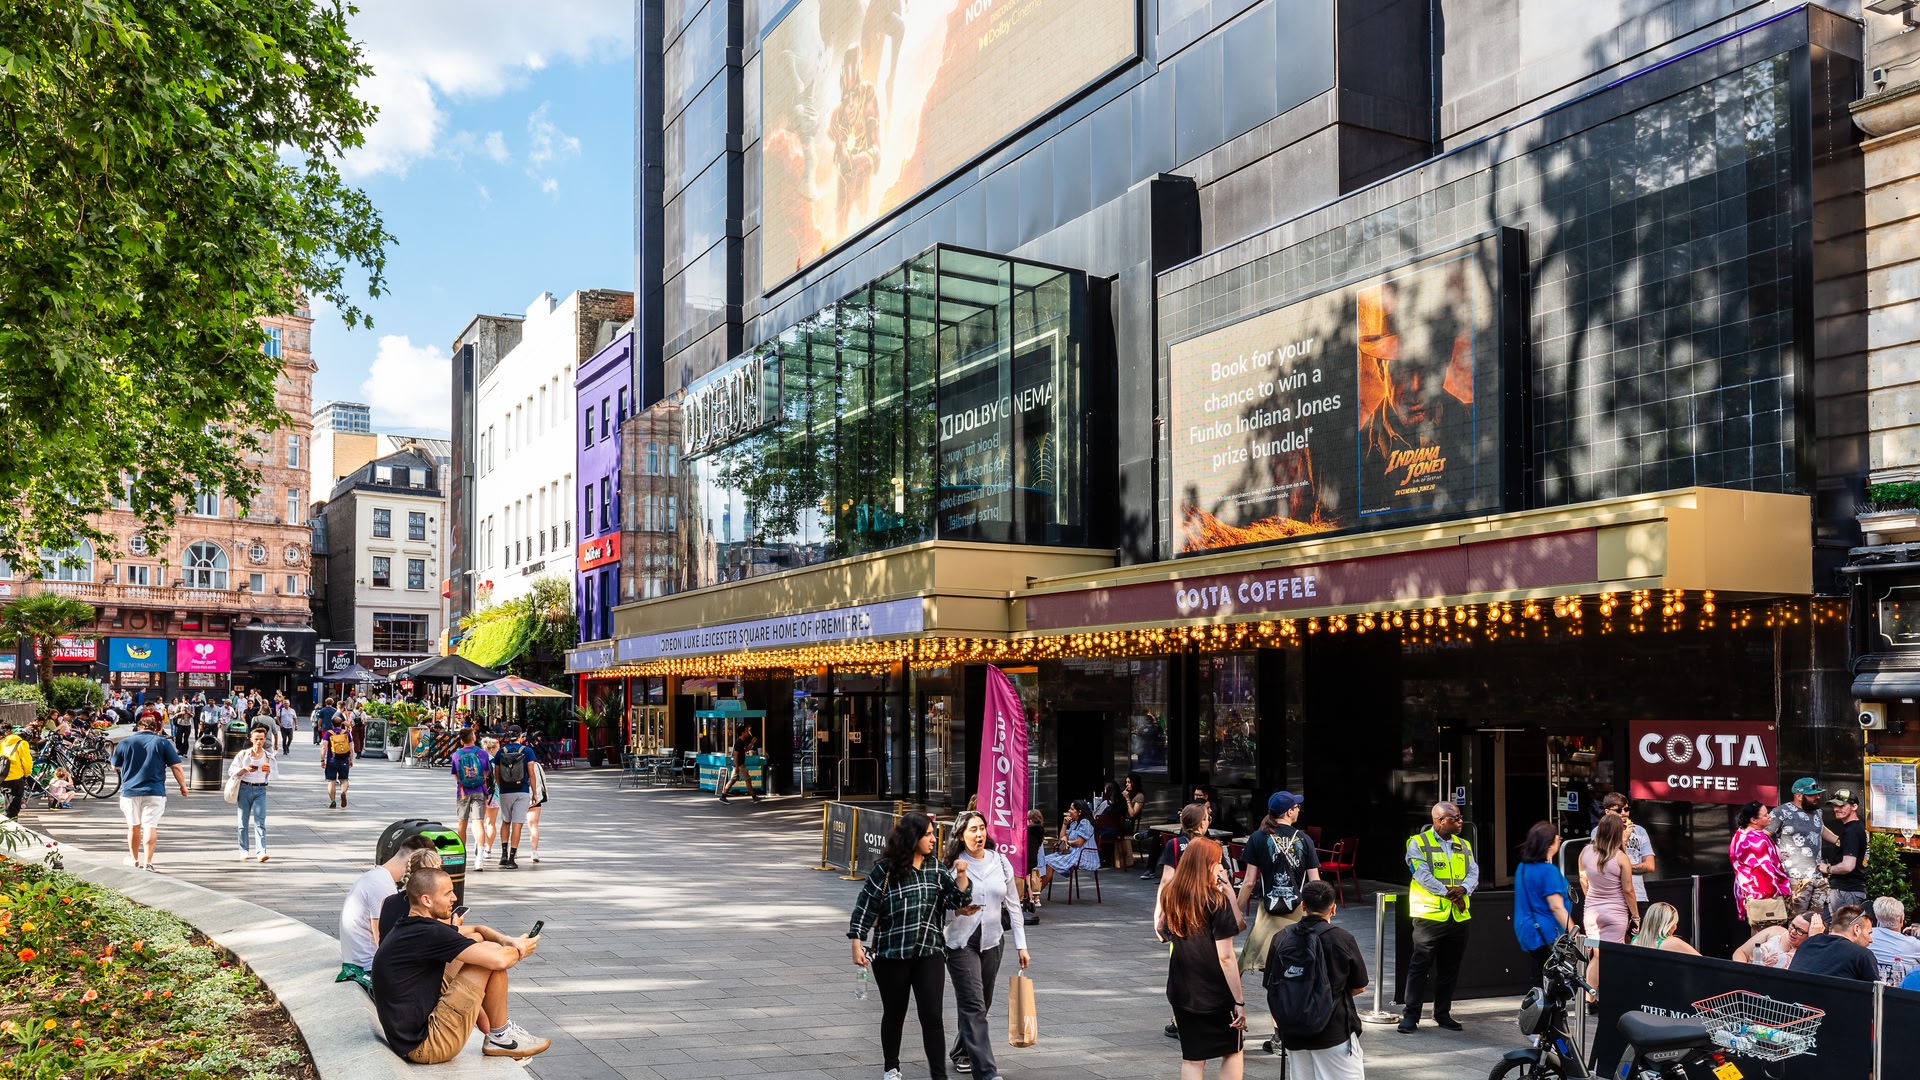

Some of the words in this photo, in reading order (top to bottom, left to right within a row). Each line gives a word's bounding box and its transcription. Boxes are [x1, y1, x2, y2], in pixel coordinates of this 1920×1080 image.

[989, 19, 1011, 43] Dolby
[1011, 0, 1042, 25] Cinema
[1211, 356, 1248, 382] Book
[1251, 350, 1274, 369] for
[1278, 338, 1314, 366] your
[682, 356, 764, 455] ODEON
[955, 400, 999, 435] DOLBY
[1000, 382, 1053, 419] CNEMA
[1204, 388, 1254, 413] chance
[1258, 381, 1274, 398] to
[1278, 369, 1307, 392] win
[1312, 368, 1322, 383] a
[1190, 422, 1232, 445] Funko
[1236, 409, 1291, 433] Indiana
[1295, 394, 1341, 420] Jones
[1213, 446, 1248, 472] prize
[1384, 446, 1440, 475] INDIANA
[1400, 458, 1446, 486] JONES
[1176, 585, 1232, 610] COSTA
[1238, 575, 1317, 604] COFFEE
[660, 636, 682, 652] ODEON
[683, 633, 700, 649] LUXE
[701, 629, 737, 648] LEICESTER
[739, 625, 770, 644] SQUARE
[772, 621, 797, 640] HOME
[800, 620, 812, 637] OF
[815, 612, 870, 635] PREMIERES
[373, 658, 398, 668] Bella
[1639, 732, 1770, 770] COSTA
[1667, 774, 1739, 791] COFFEE
[864, 832, 886, 847] COSTA
[1640, 1005, 1666, 1017] THE
